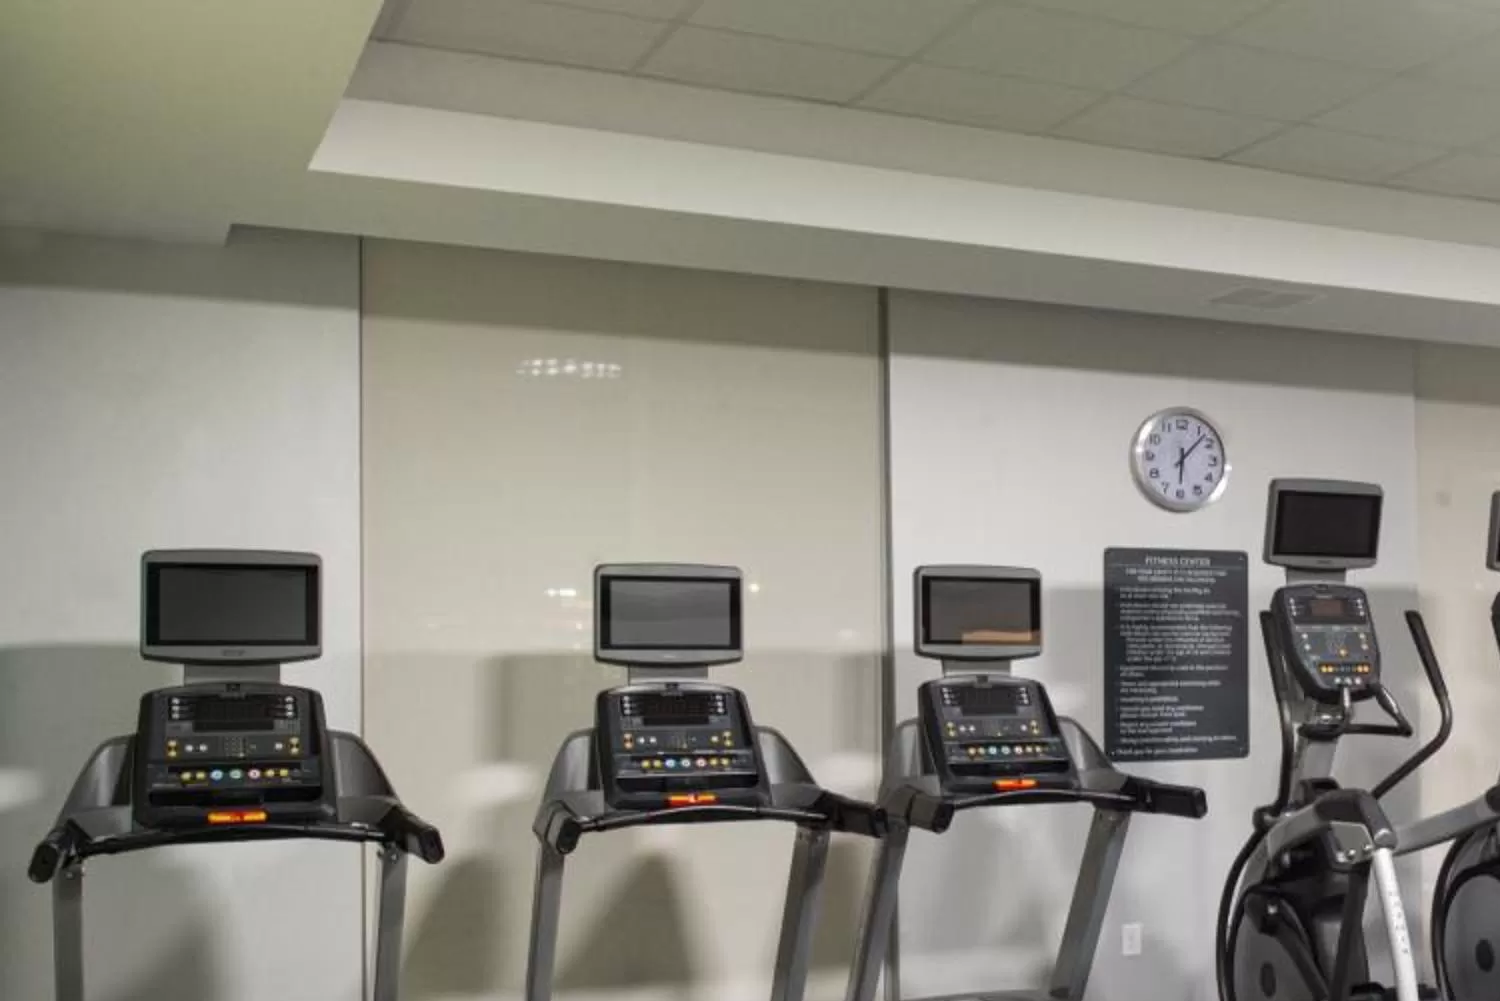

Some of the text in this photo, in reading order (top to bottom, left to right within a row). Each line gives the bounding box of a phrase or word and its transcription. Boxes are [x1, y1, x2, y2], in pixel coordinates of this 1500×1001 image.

[1149, 433, 1161, 445] 10
[1205, 438, 1214, 449] 2
[1208, 455, 1217, 467] 3
[1149, 467, 1159, 478] 8
[1204, 472, 1213, 482] 4
[1161, 482, 1169, 494] 7
[1176, 488, 1185, 499] 6
[1192, 484, 1202, 496] 5
[1145, 555, 1211, 567] FITNESS CENTER
